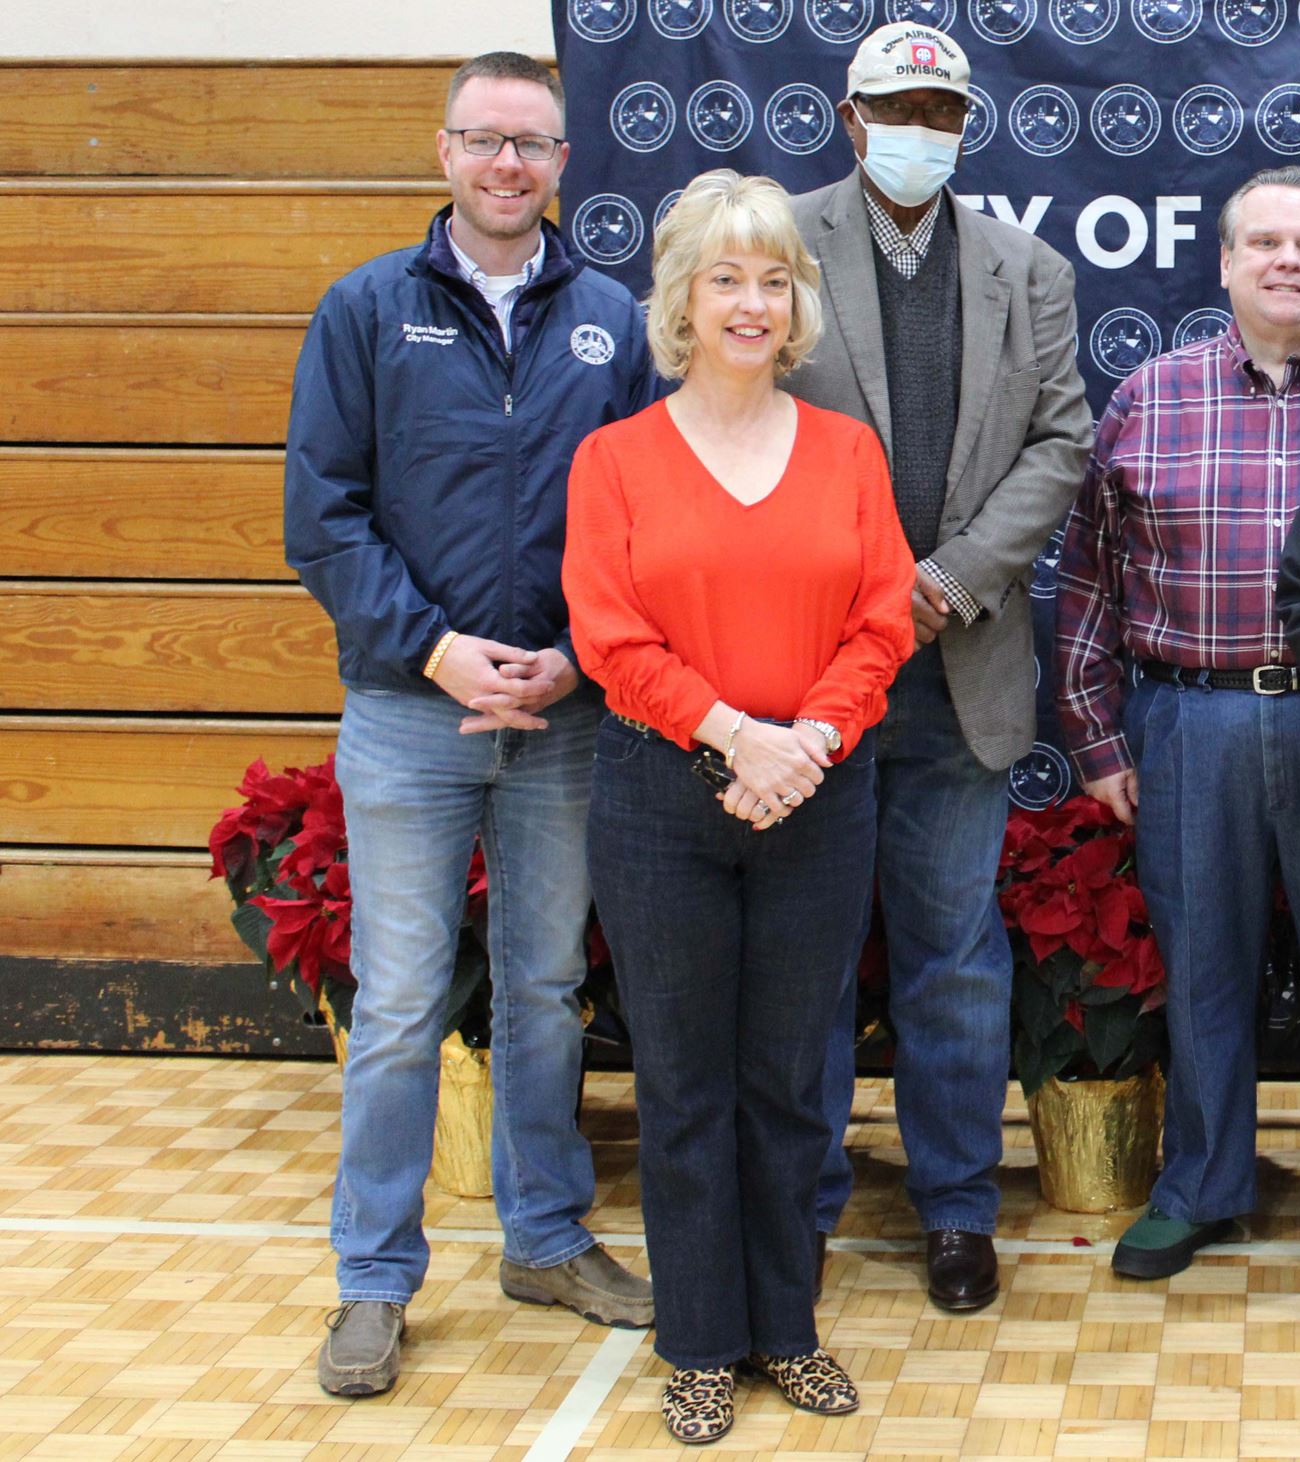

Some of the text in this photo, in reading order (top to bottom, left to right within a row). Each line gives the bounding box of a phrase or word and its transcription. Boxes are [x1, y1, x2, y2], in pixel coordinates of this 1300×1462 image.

[905, 30, 957, 60] AIRBORNE
[896, 64, 951, 80] DIVISION
[1075, 194, 1202, 269] OF
[403, 323, 459, 336] Ryan Martin
[405, 334, 455, 345] City Manager
